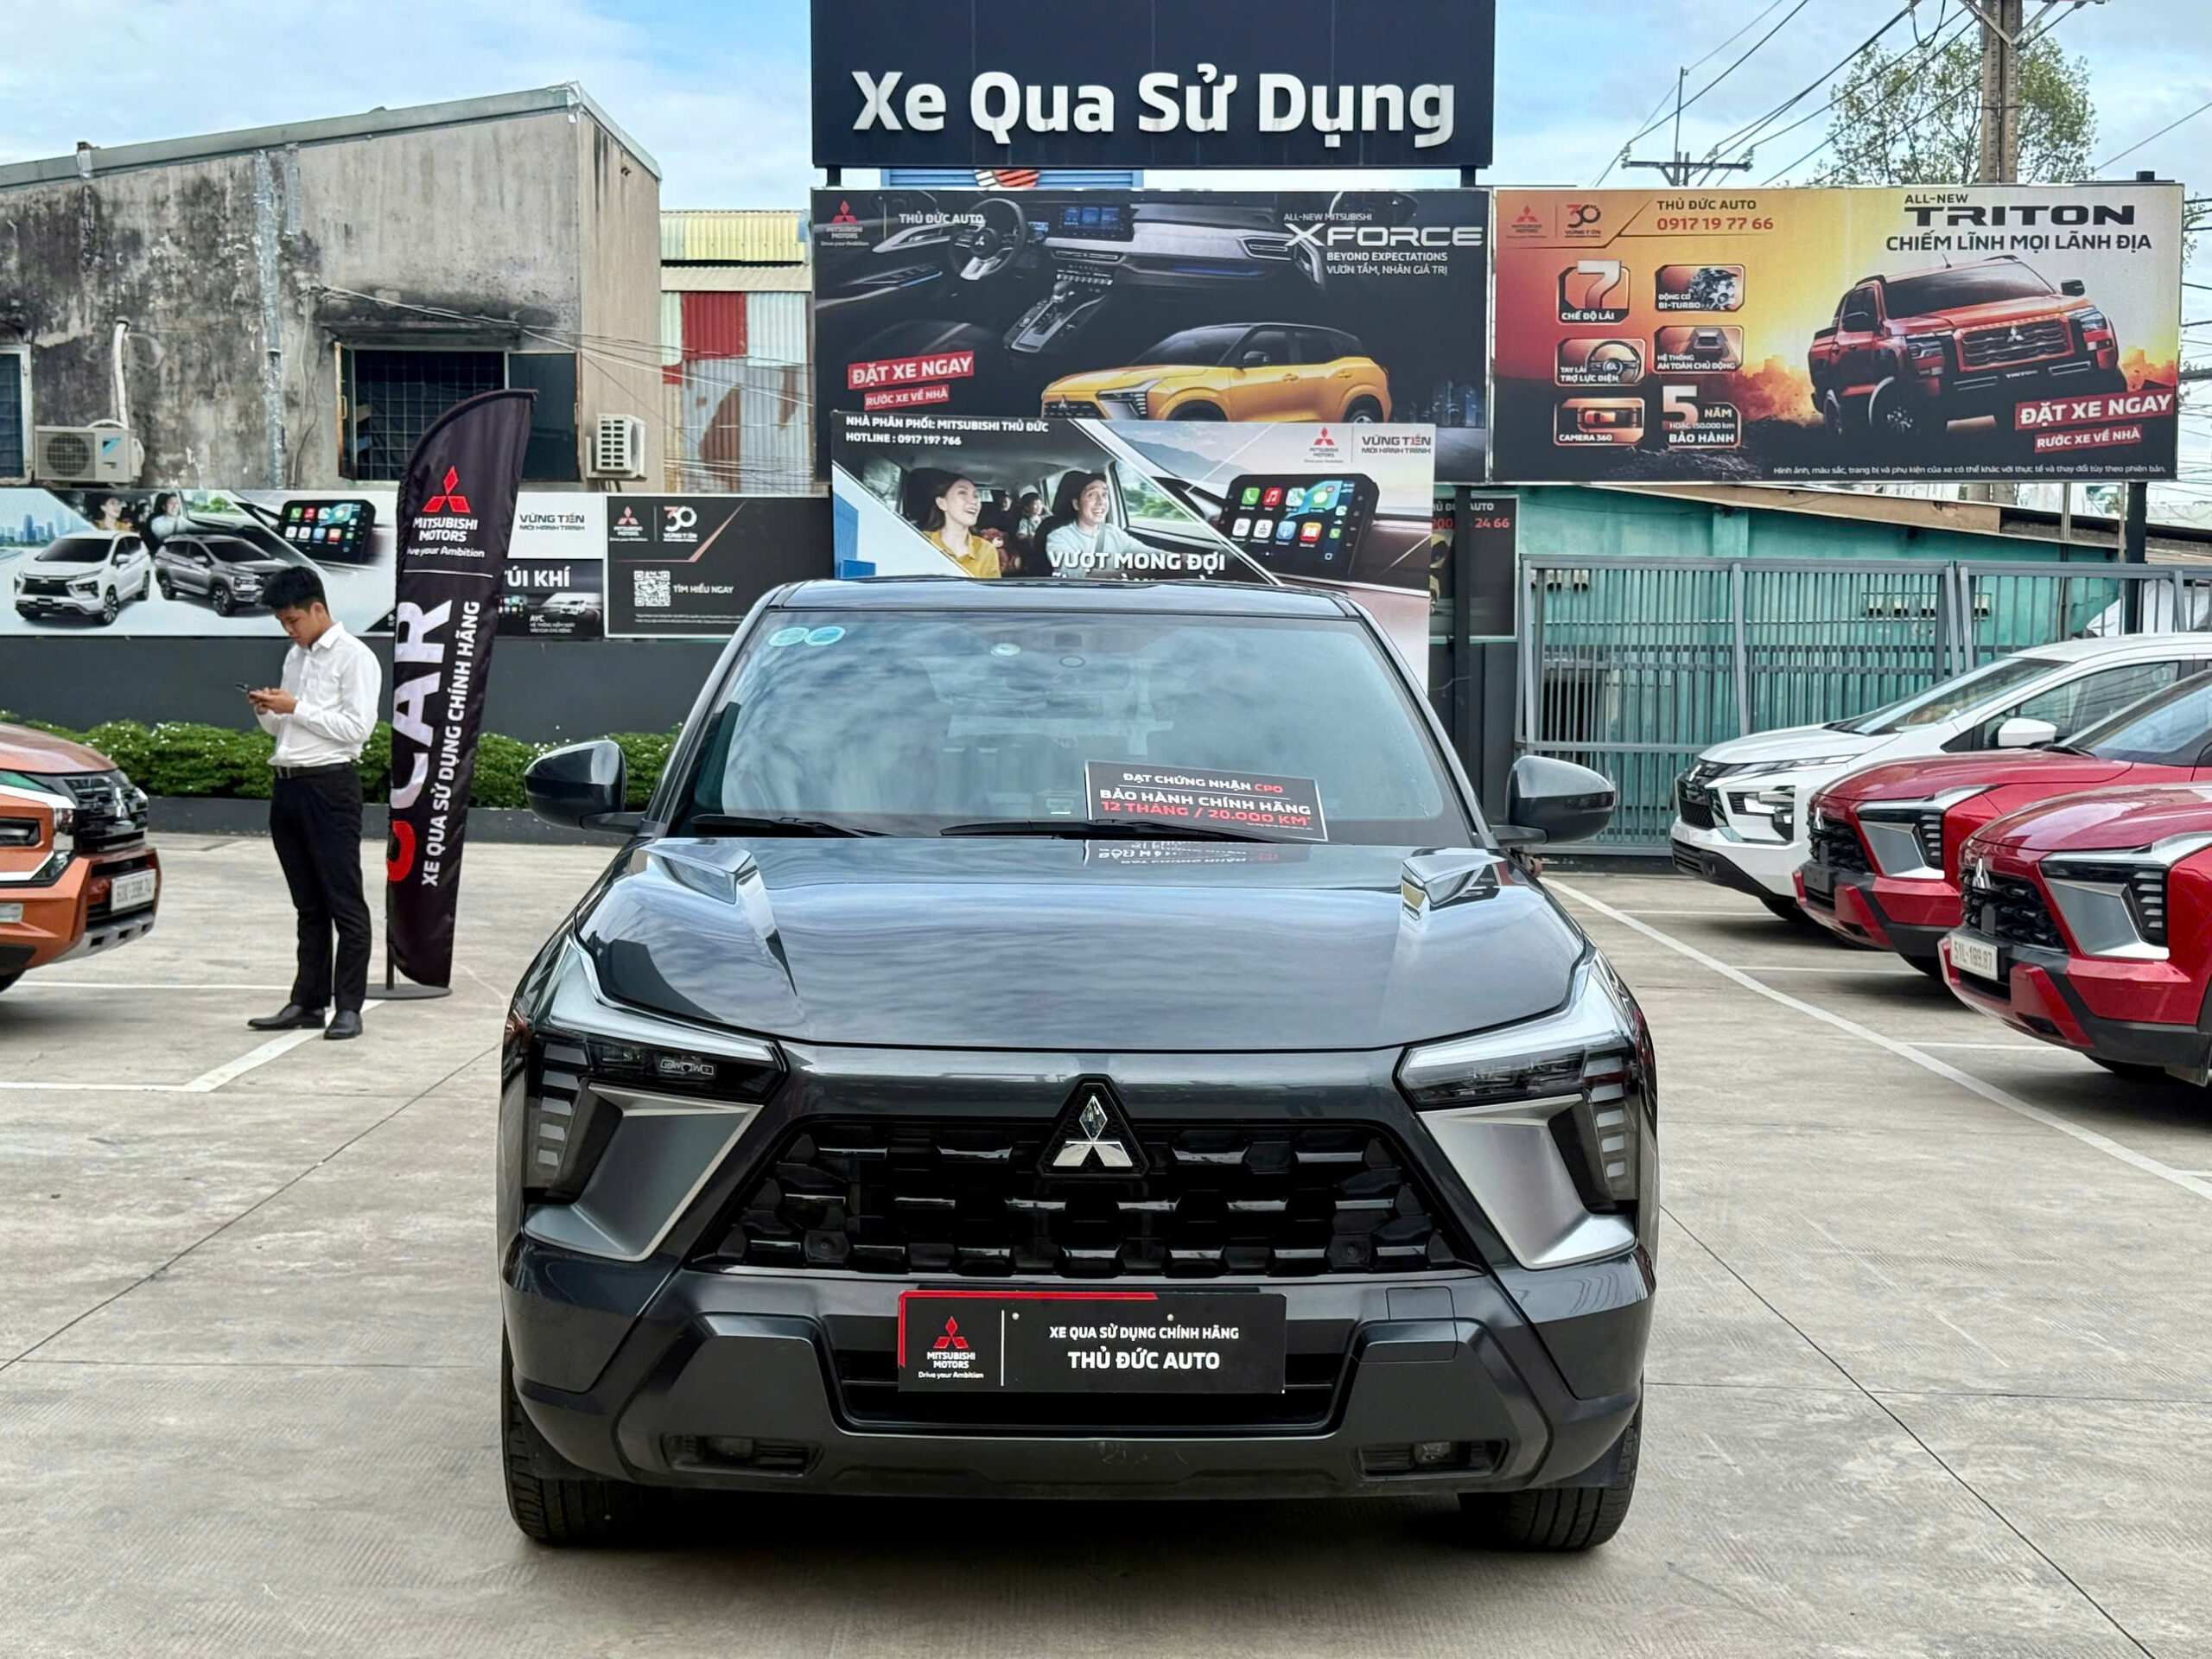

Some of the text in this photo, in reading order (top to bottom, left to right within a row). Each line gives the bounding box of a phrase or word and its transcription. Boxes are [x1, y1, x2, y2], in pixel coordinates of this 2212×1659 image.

[852, 62, 1454, 148] Xe Qua Sử Dụng
[1657, 197, 1757, 210] THỦ ĐỨC AUTO
[1904, 194, 1968, 204] ALL-NEW
[899, 210, 984, 224] THỦ ĐỨC AUTO
[1904, 205, 2135, 226] TRITON
[1657, 217, 1774, 231] 0917 19 77 66
[1284, 223, 1484, 246] XFORCE
[1886, 230, 2152, 253] CHIẾM LĨNH MỌI LÃNH ĐỊA
[1326, 252, 1447, 261] BEYOND EXPECTATIONS
[1577, 260, 1621, 308] 7
[1561, 310, 1614, 321] CHẾ ĐỘ LÁI
[852, 357, 973, 386] ĐẶT XE NGAY
[866, 387, 949, 407] RƯỚC XE VỀ NHÀ
[1662, 385, 1732, 429] 5 NĂM
[2019, 394, 2172, 427] ĐẶT XE NGAY
[846, 413, 871, 427] NHÀ
[872, 413, 904, 429] PHÂN
[937, 419, 1000, 431] MITSUBISHI
[1001, 418, 1024, 431] THỦ
[1027, 419, 1049, 432] ĐỨC
[846, 432, 962, 446] HOTLINE 0917 197 766
[1362, 434, 1400, 445] VỮNG
[1669, 430, 1734, 443] BẢO HÀNH
[2037, 427, 2140, 448] RƯỚC XE VỀ NHÀ
[1848, 467, 1870, 475] trang
[412, 517, 478, 531] MITSUBISHI
[519, 512, 556, 523] VỮNG
[1475, 518, 1510, 528] 24 66
[419, 530, 467, 542] MOTORS
[421, 547, 439, 558] your
[440, 546, 485, 559] Ambition
[1048, 549, 1225, 575] VƯỢT MONG ĐỢI
[534, 565, 571, 588] KHÍ
[711, 585, 734, 594] NGAY
[422, 601, 480, 887] XE QUA SỬ DỤNG CHÍNH HÃNG
[1123, 772, 1283, 793] ĐẠT CHỨNG NHẬN CPO
[1100, 787, 1311, 816] BẢO HÀNH CHÍNH HÃNG
[1101, 801, 1122, 812] 12
[1124, 802, 1189, 817] THÁNG
[1208, 810, 1274, 823] 20.000
[1049, 1323, 1239, 1343] XE QUA SỬ DỤNG CHÍNH HÃNG
[927, 1351, 976, 1361] MITSUBISHI
[1067, 1346, 1220, 1370] THỦ ĐỨC AUTO
[932, 1360, 969, 1370] MOTORS
[938, 1372, 952, 1381] your
